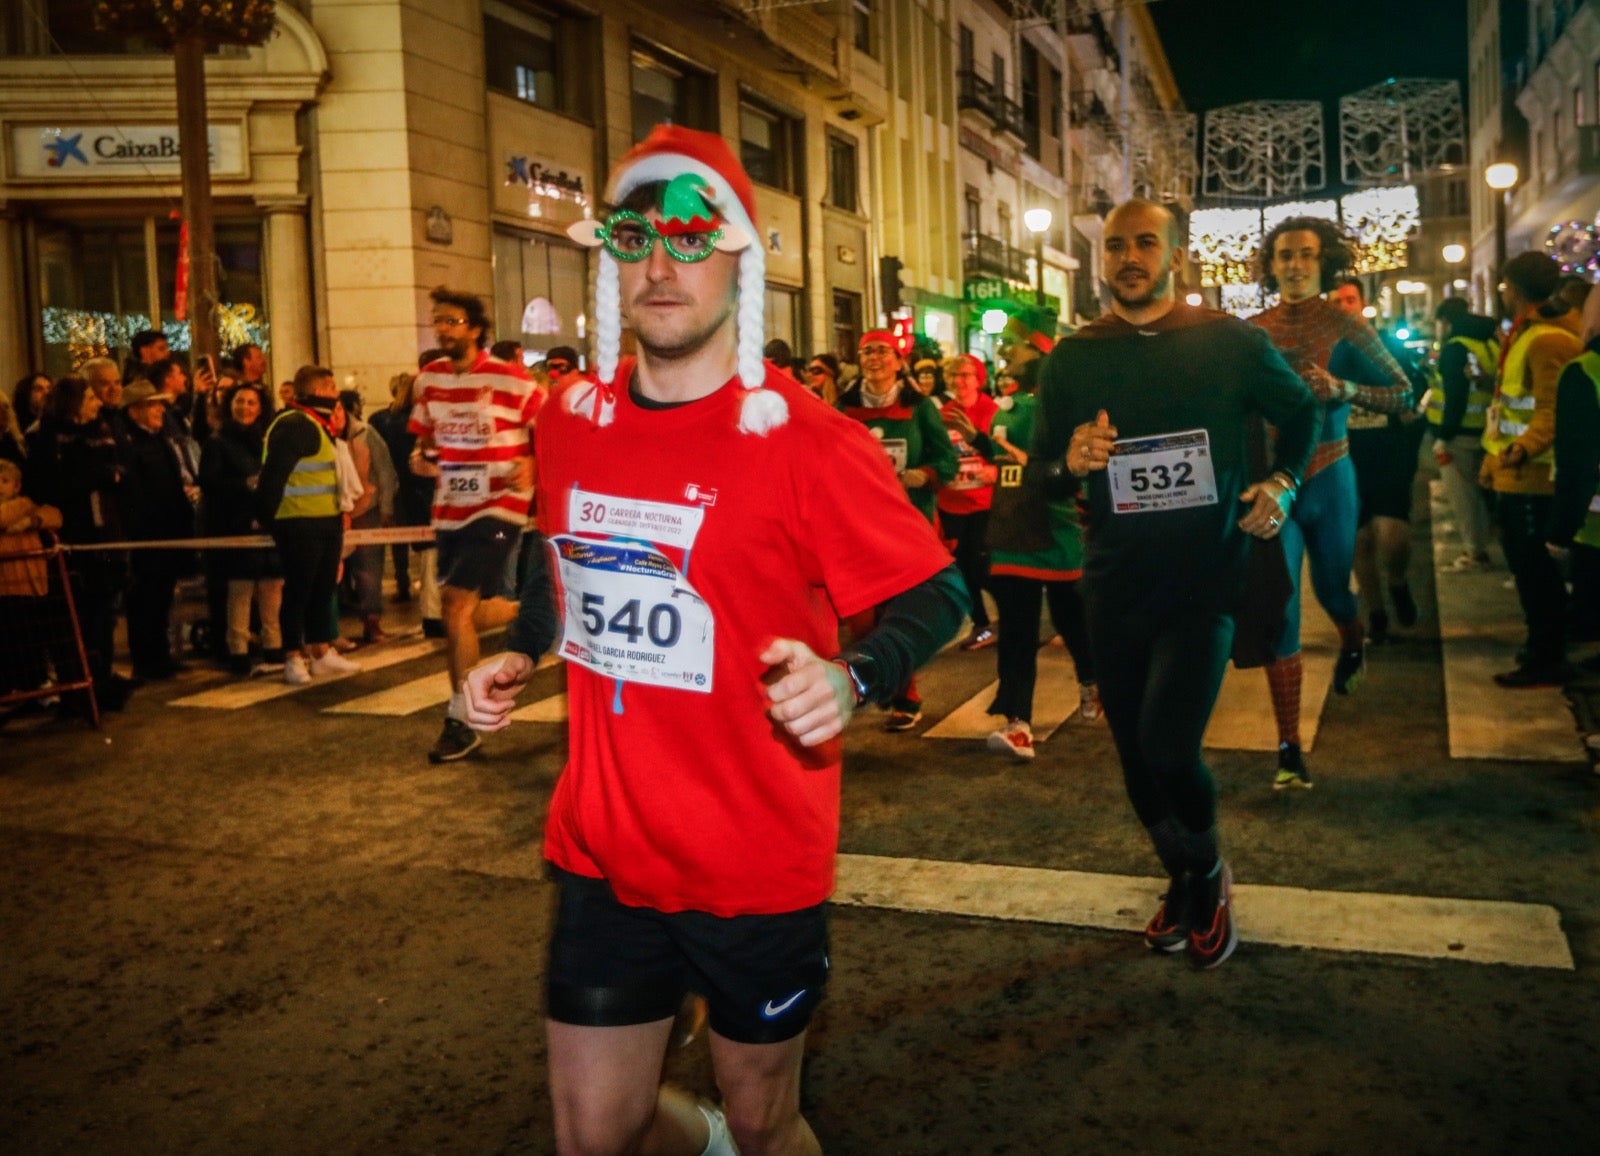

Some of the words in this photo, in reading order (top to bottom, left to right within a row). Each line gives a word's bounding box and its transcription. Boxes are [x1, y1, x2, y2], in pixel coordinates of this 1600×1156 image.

[94, 135, 214, 159] CaixaB
[967, 281, 1003, 300] 16H
[448, 477, 479, 492] 526
[1130, 461, 1195, 492] 532
[580, 500, 606, 524] 30
[644, 510, 683, 526] NOCTURNA
[582, 591, 682, 648] 540
[602, 645, 626, 660] GARCIA
[626, 650, 667, 664] RODRIGUEZ
